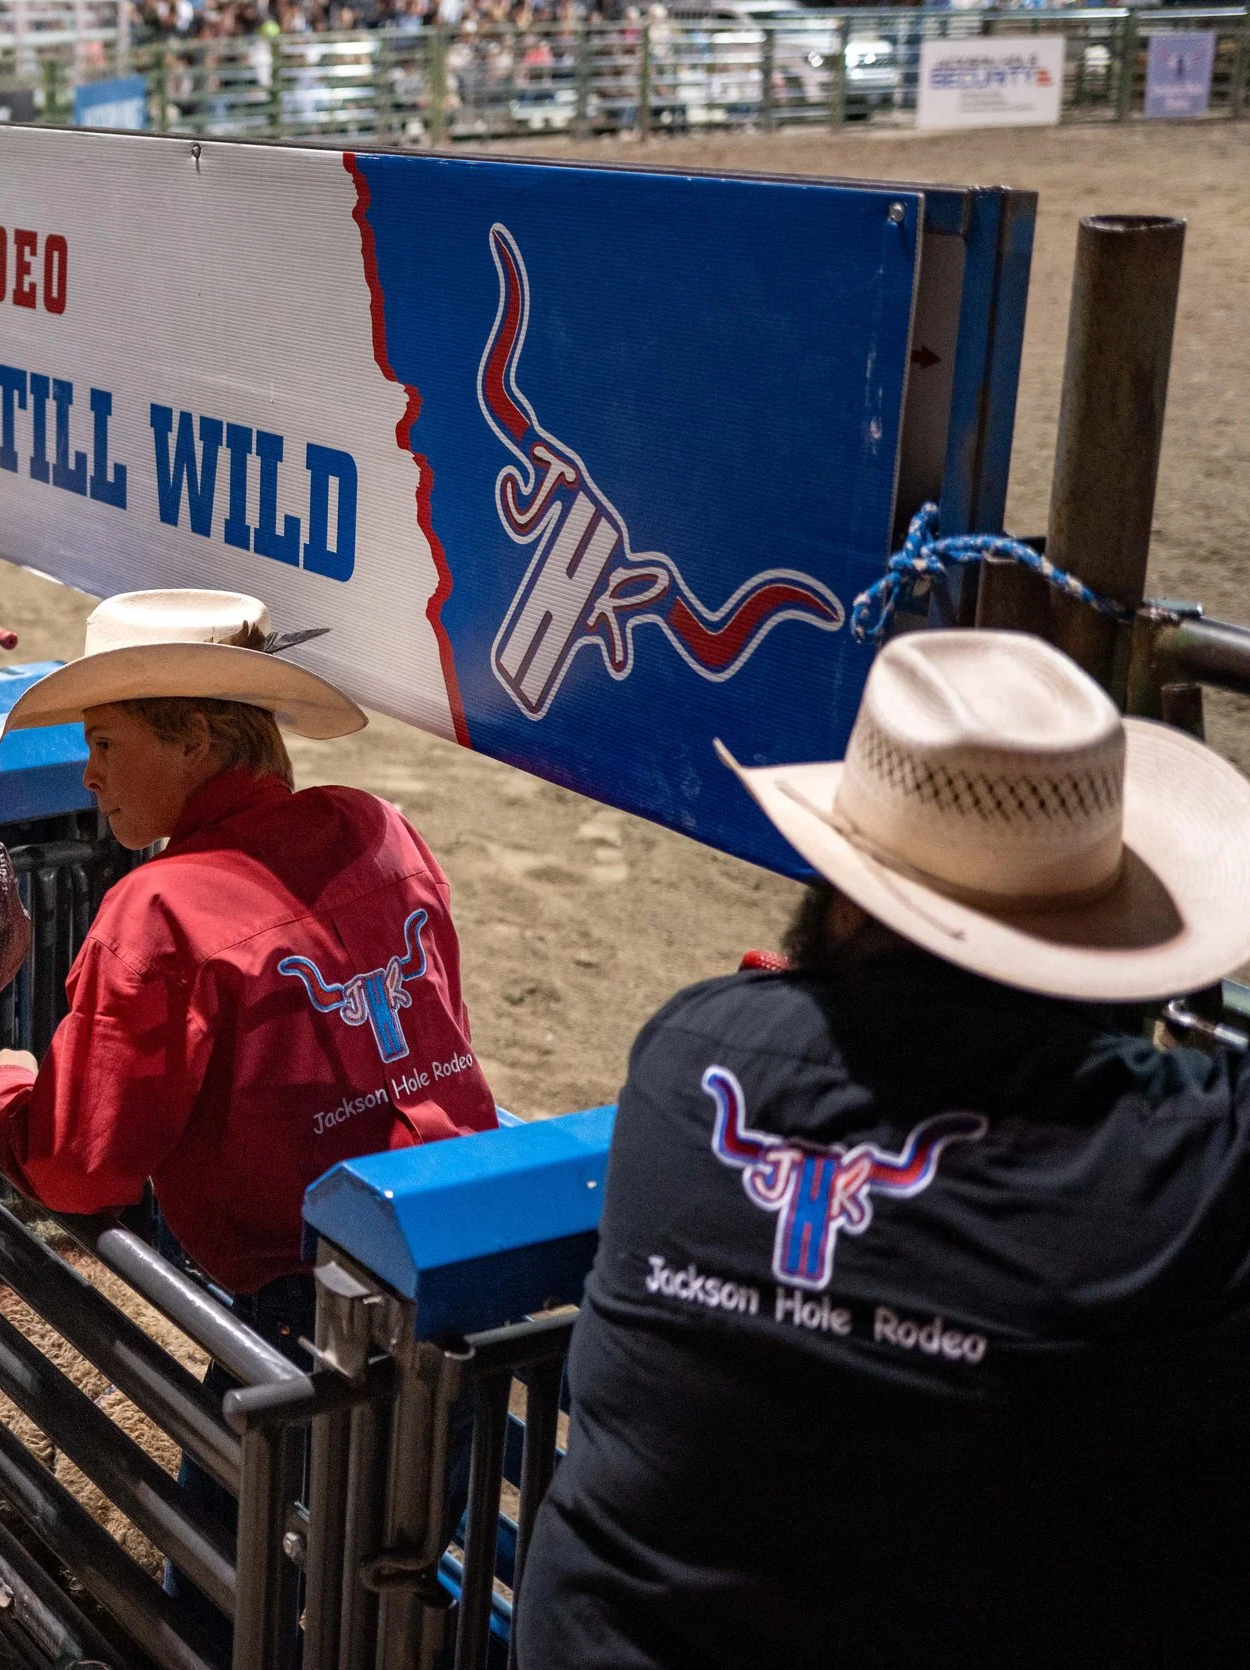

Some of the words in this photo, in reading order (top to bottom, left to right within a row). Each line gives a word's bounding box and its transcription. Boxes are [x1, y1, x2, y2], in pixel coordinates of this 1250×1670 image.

[150, 402, 358, 582] WILD
[313, 1087, 389, 1135] Jackson
[392, 1067, 431, 1099] Hole
[432, 1052, 473, 1082] Rodeo
[646, 1255, 760, 1315] Jackson
[774, 1286, 852, 1335] Hole
[873, 1306, 988, 1364] Rodeo
